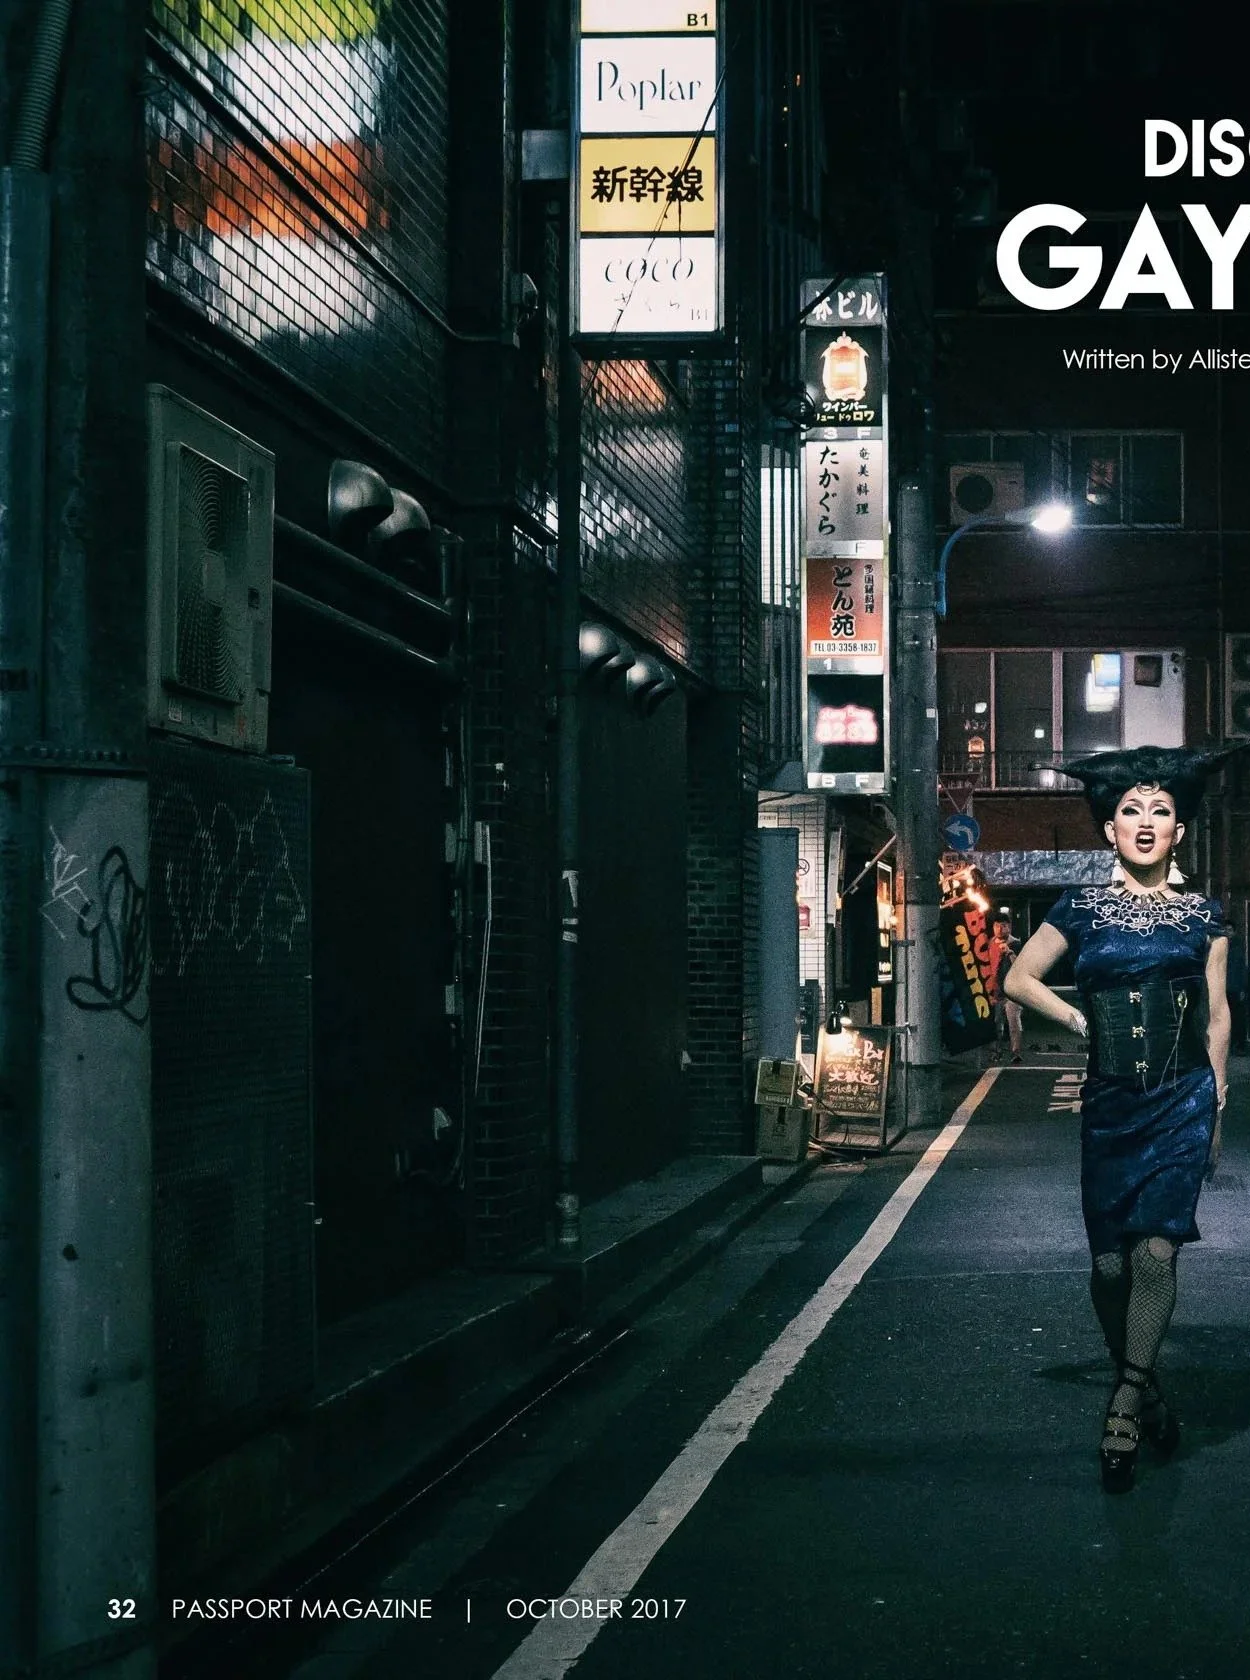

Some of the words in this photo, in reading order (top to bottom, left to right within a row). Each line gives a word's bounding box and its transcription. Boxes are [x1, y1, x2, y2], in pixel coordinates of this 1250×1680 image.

[687, 13, 709, 27] B1
[597, 60, 702, 111] Poplar
[590, 165, 705, 204] 新幹線
[604, 257, 694, 283] coco
[822, 401, 868, 413] ワインバー
[817, 445, 840, 536] たかぐら
[831, 564, 856, 638] とん苑
[814, 642, 826, 653] TEL
